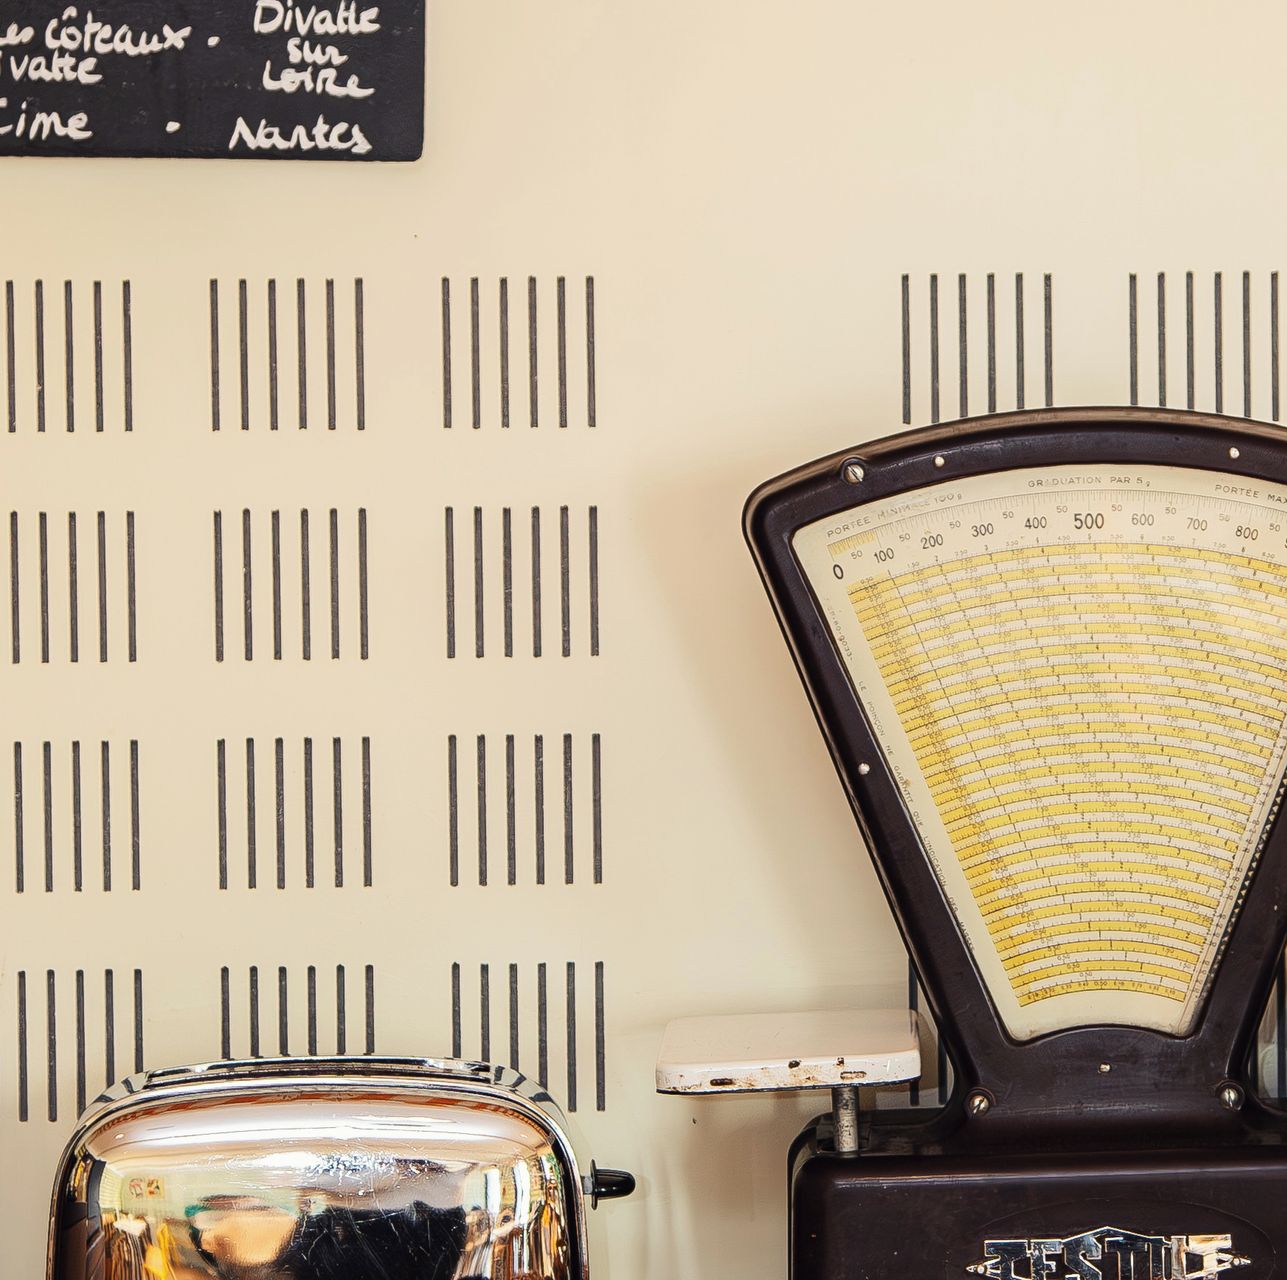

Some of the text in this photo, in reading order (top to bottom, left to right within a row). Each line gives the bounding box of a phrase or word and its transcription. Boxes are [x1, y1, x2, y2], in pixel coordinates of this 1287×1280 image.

[287, 38, 349, 67] sur
[228, 114, 373, 155] Nantes
[1110, 476, 1132, 485] PAR
[873, 547, 895, 564] 100
[920, 533, 944, 550] 200
[971, 522, 994, 538] 300
[1024, 516, 1048, 529] 400
[1073, 513, 1104, 529] 500
[1131, 513, 1154, 526] 600
[1186, 517, 1208, 531] 700
[1235, 525, 1259, 541] 800
